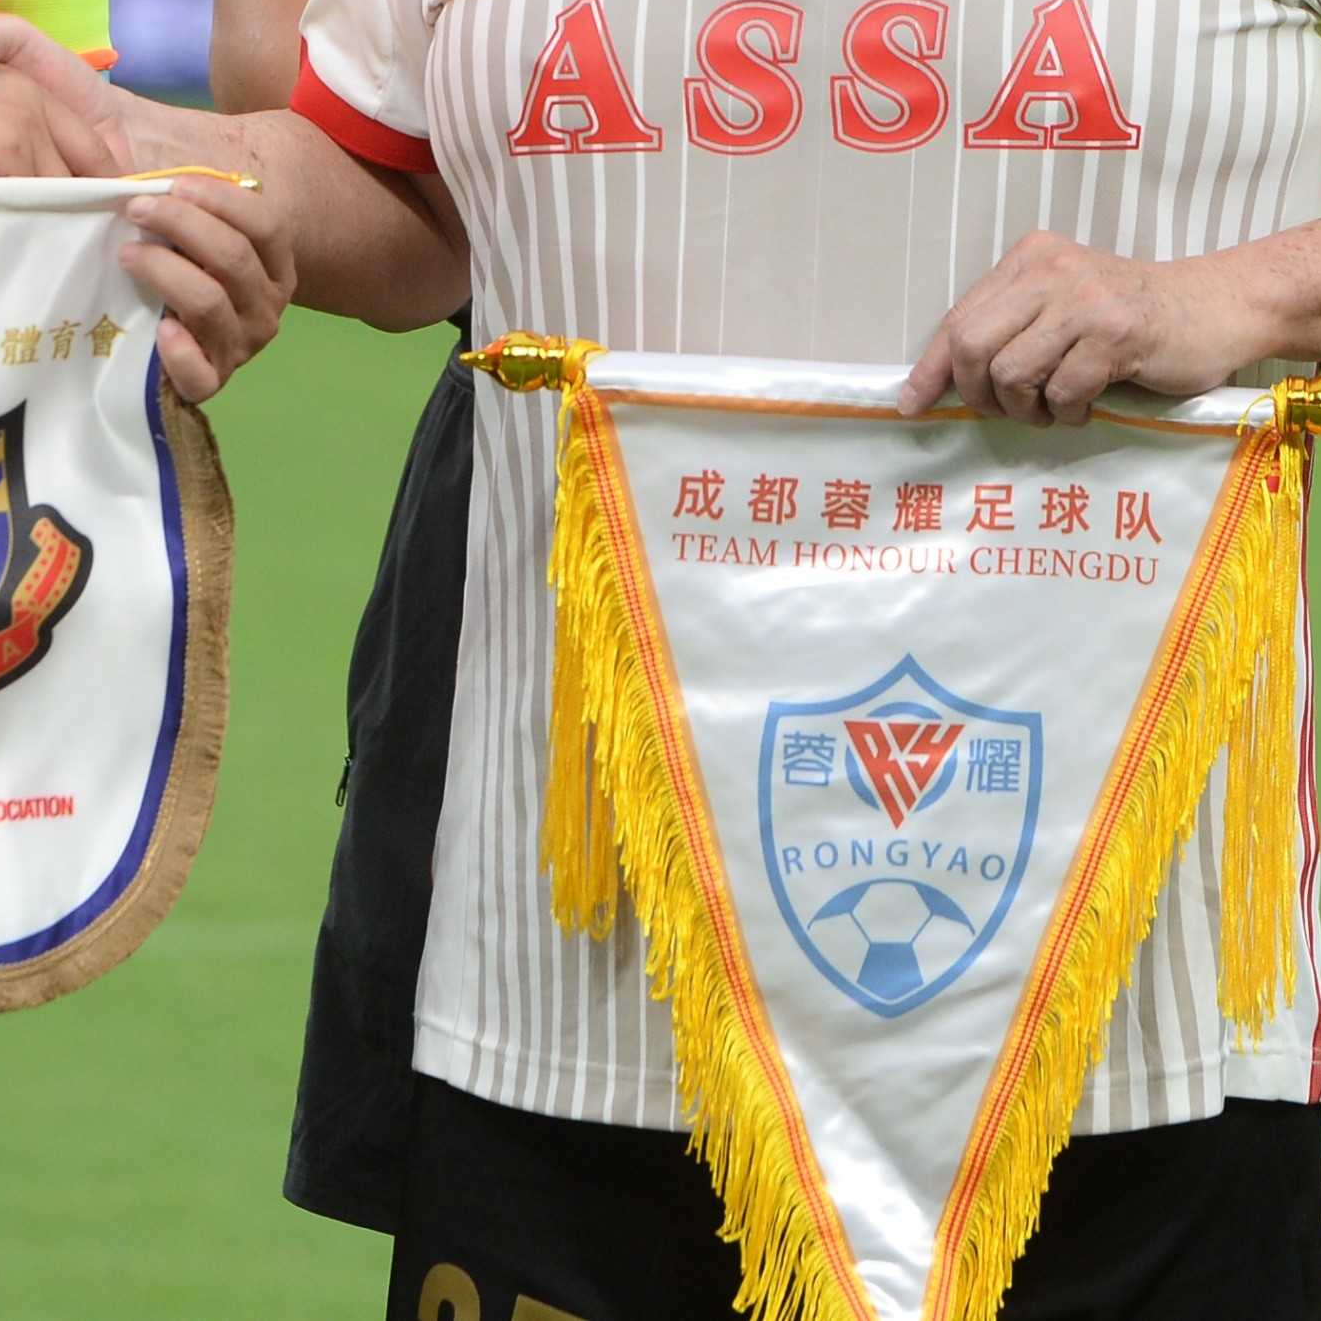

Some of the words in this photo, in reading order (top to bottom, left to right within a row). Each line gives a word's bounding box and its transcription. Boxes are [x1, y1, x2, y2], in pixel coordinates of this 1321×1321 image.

[672, 469, 1164, 545] 成都蓉耀足球队
[671, 532, 779, 567] TEAM
[792, 540, 957, 574] HONOUR
[969, 546, 1161, 585] CHENGDU
[781, 731, 837, 787] 蓉
[965, 737, 1023, 793] 耀
[781, 838, 1006, 882] RONGYAO
